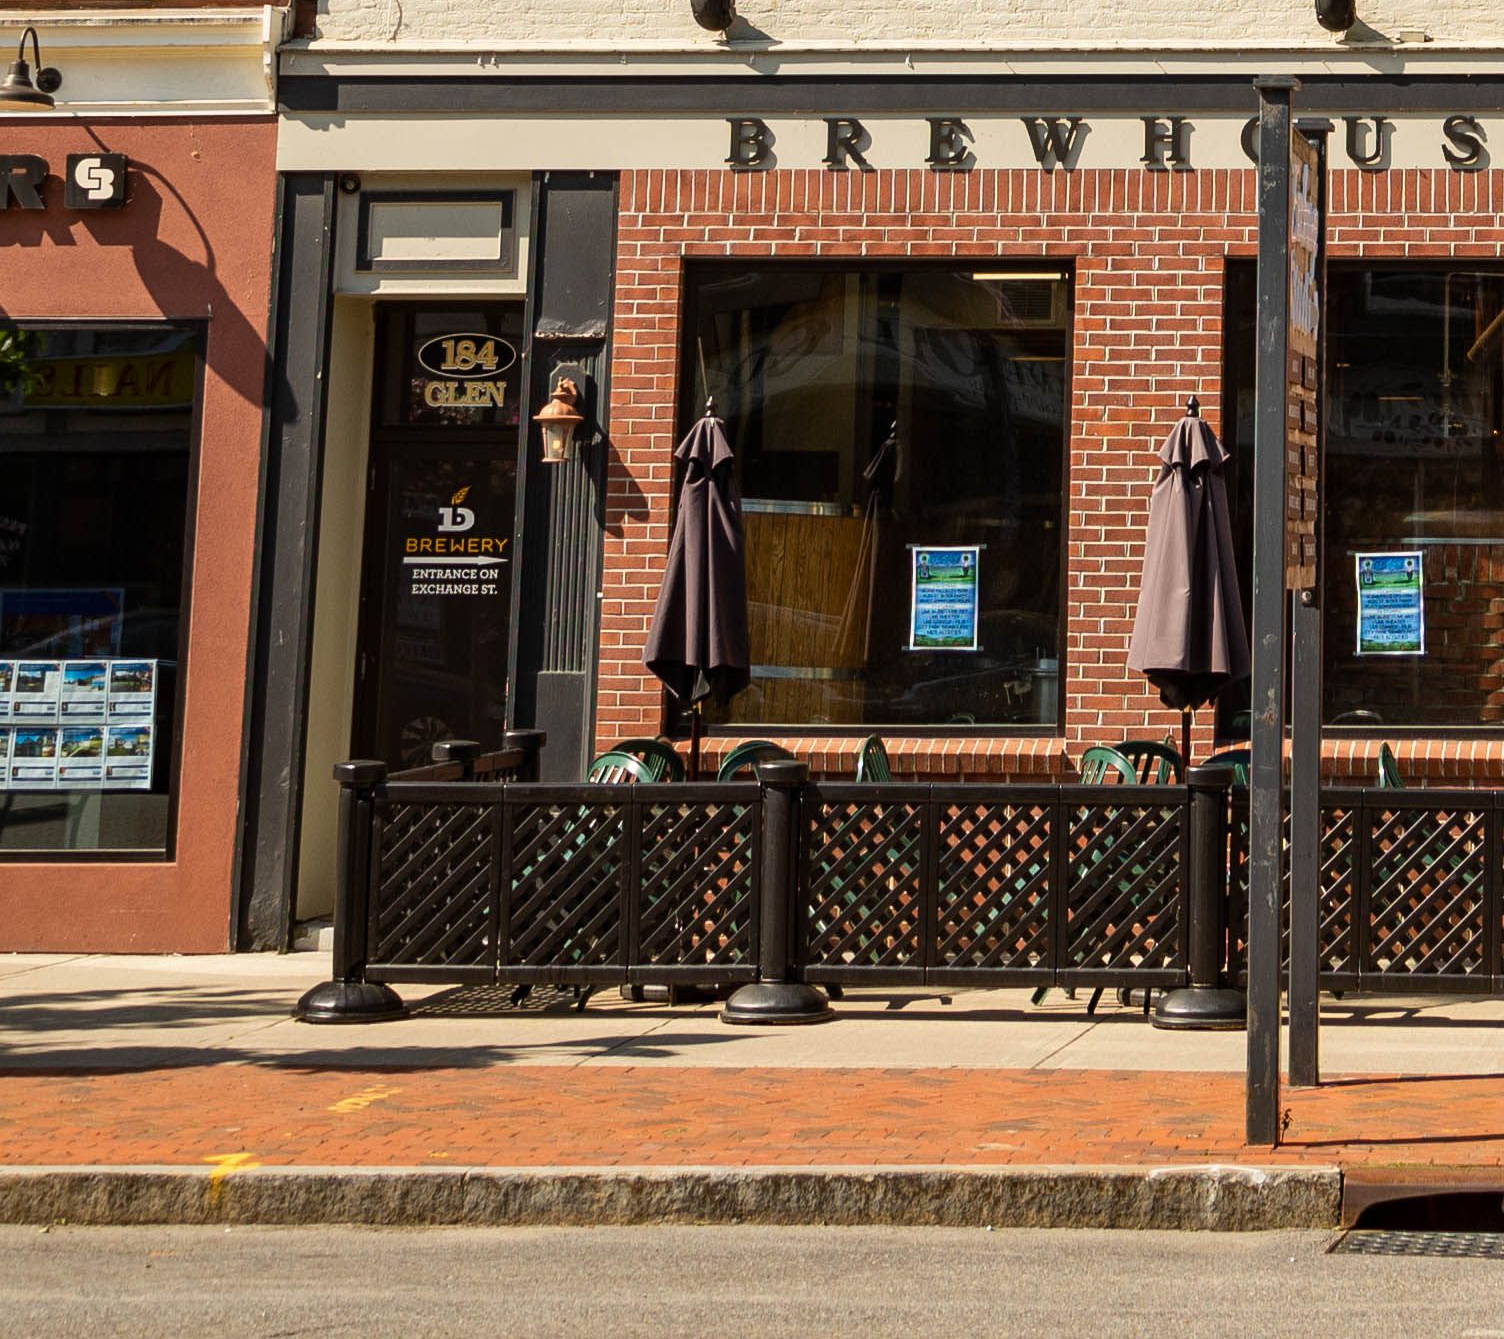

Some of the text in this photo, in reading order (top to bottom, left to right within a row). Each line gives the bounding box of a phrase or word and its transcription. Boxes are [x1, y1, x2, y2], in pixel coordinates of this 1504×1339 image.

[441, 339, 499, 370] 184
[424, 381, 507, 407] GLEN
[405, 538, 509, 553] BREWERY
[412, 569, 498, 579] ENTRANCE ON
[411, 584, 498, 595] EXCHANGE ST.
